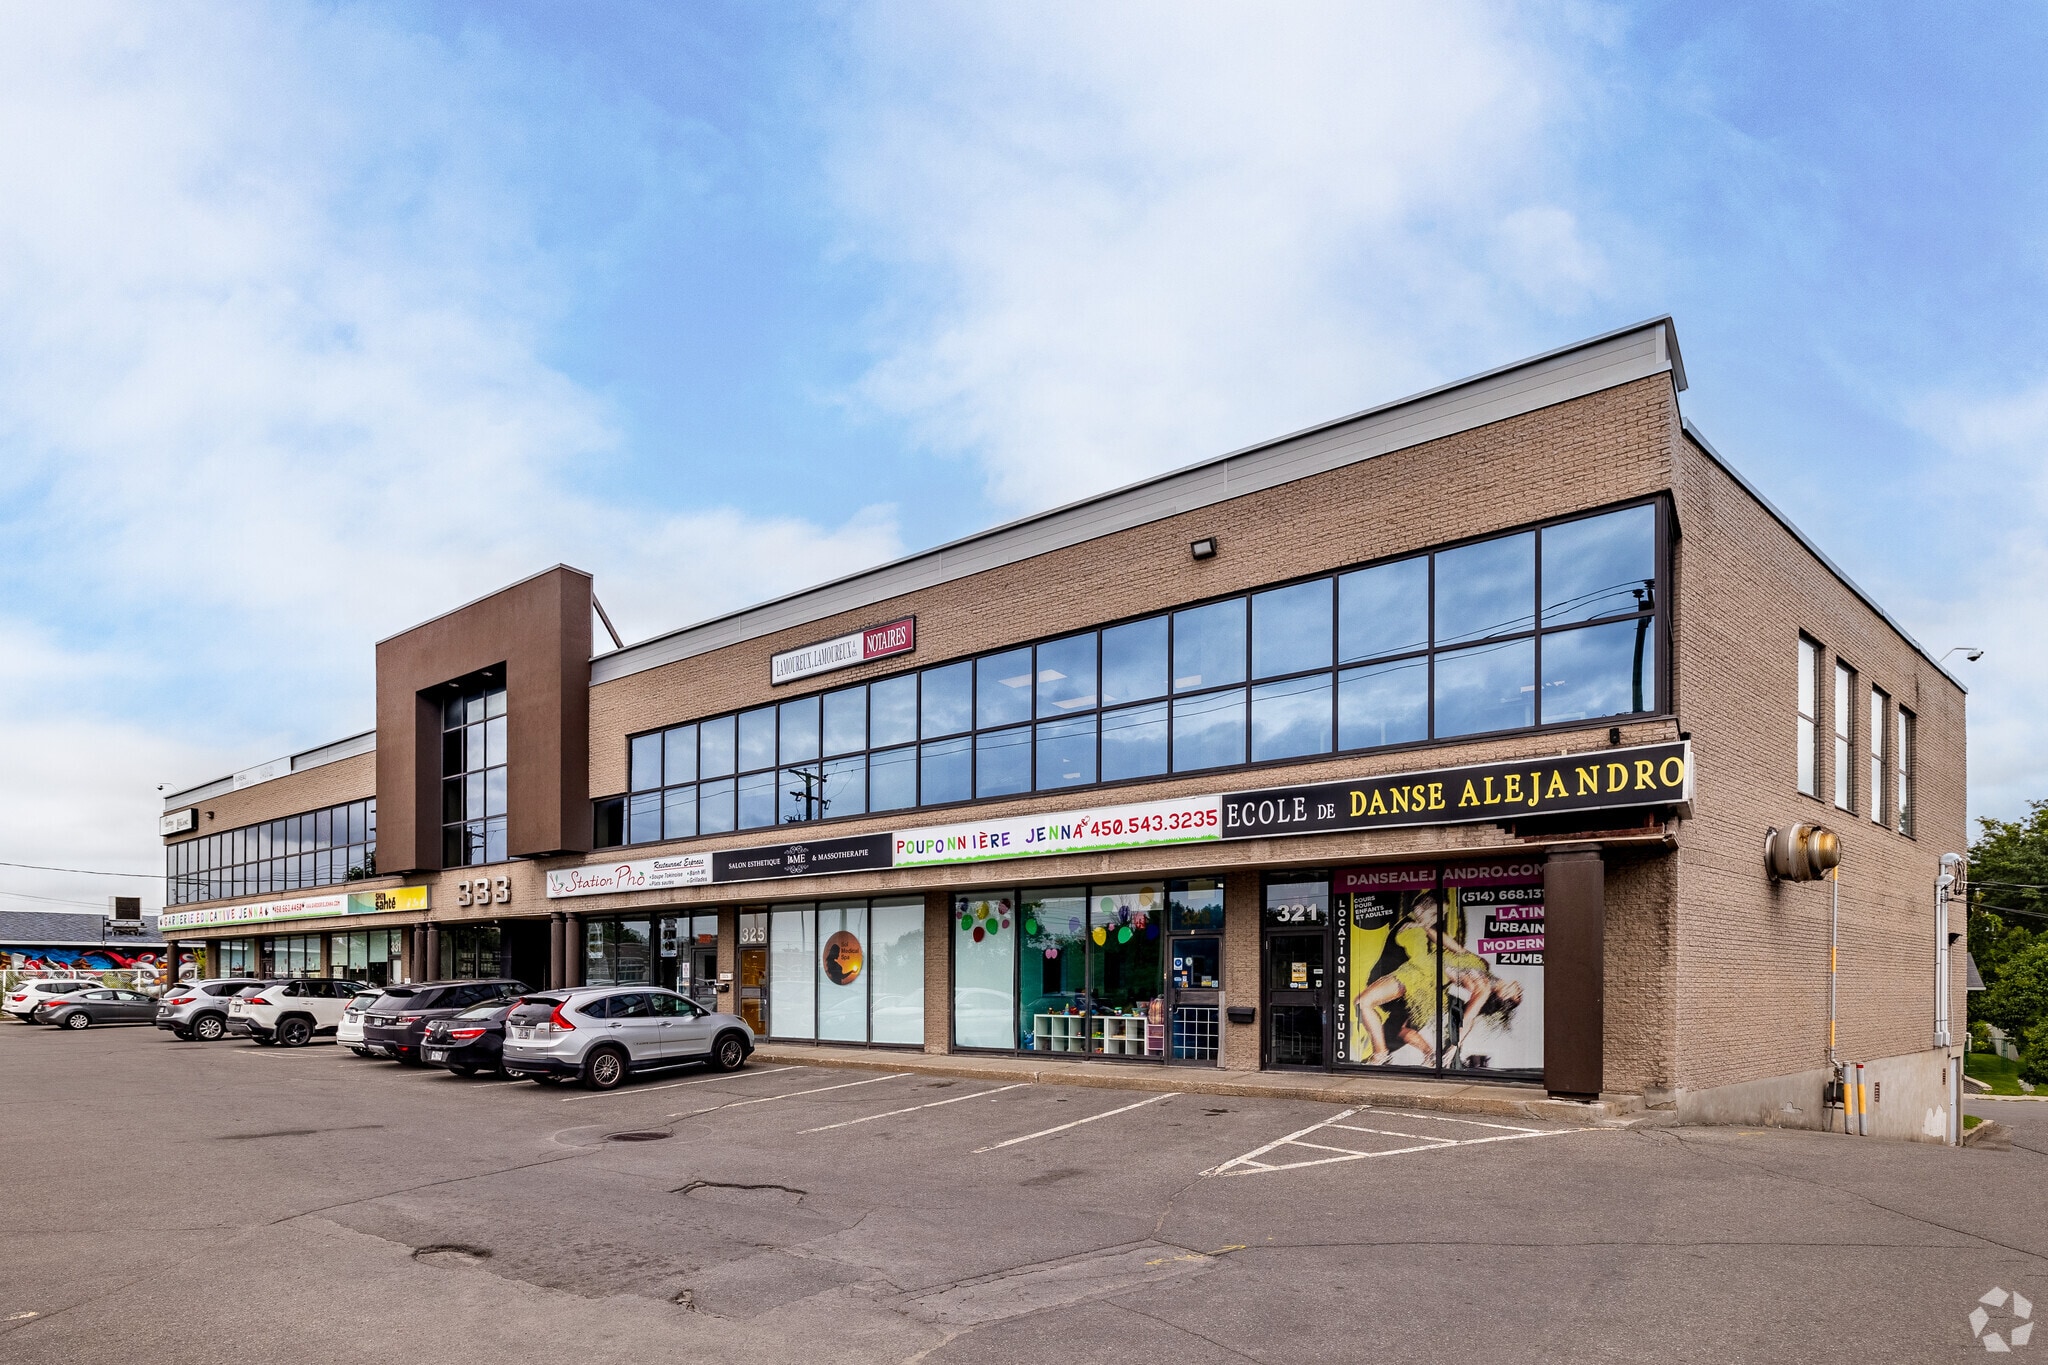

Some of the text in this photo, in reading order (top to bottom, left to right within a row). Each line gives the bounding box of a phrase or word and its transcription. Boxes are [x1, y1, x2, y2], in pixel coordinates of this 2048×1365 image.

[866, 626, 906, 654] NOTAIRES
[1226, 756, 1684, 828] ECOLE DE DANSE ALEJANDRO
[1025, 823, 1083, 844] JENNA
[1091, 809, 1218, 837] 450.543.3235
[653, 861, 683, 869] Restaurant
[728, 861, 747, 870] SALON
[747, 858, 781, 868] ESTHETIQUE
[818, 849, 869, 861] MASSOTHERAPIE
[565, 871, 613, 893] Station
[457, 876, 512, 906] 333
[1354, 895, 1376, 903] COURS
[1461, 891, 1495, 903] (514)
[238, 906, 263, 919] JENNA
[1277, 903, 1317, 921] 321
[1355, 905, 1385, 915] ENFANTS
[1365, 909, 1394, 918] ADULTES
[741, 927, 766, 942] 325
[1500, 953, 1544, 964] ZUMB
[1337, 899, 1347, 1059] LOCATION DE STUDIO
